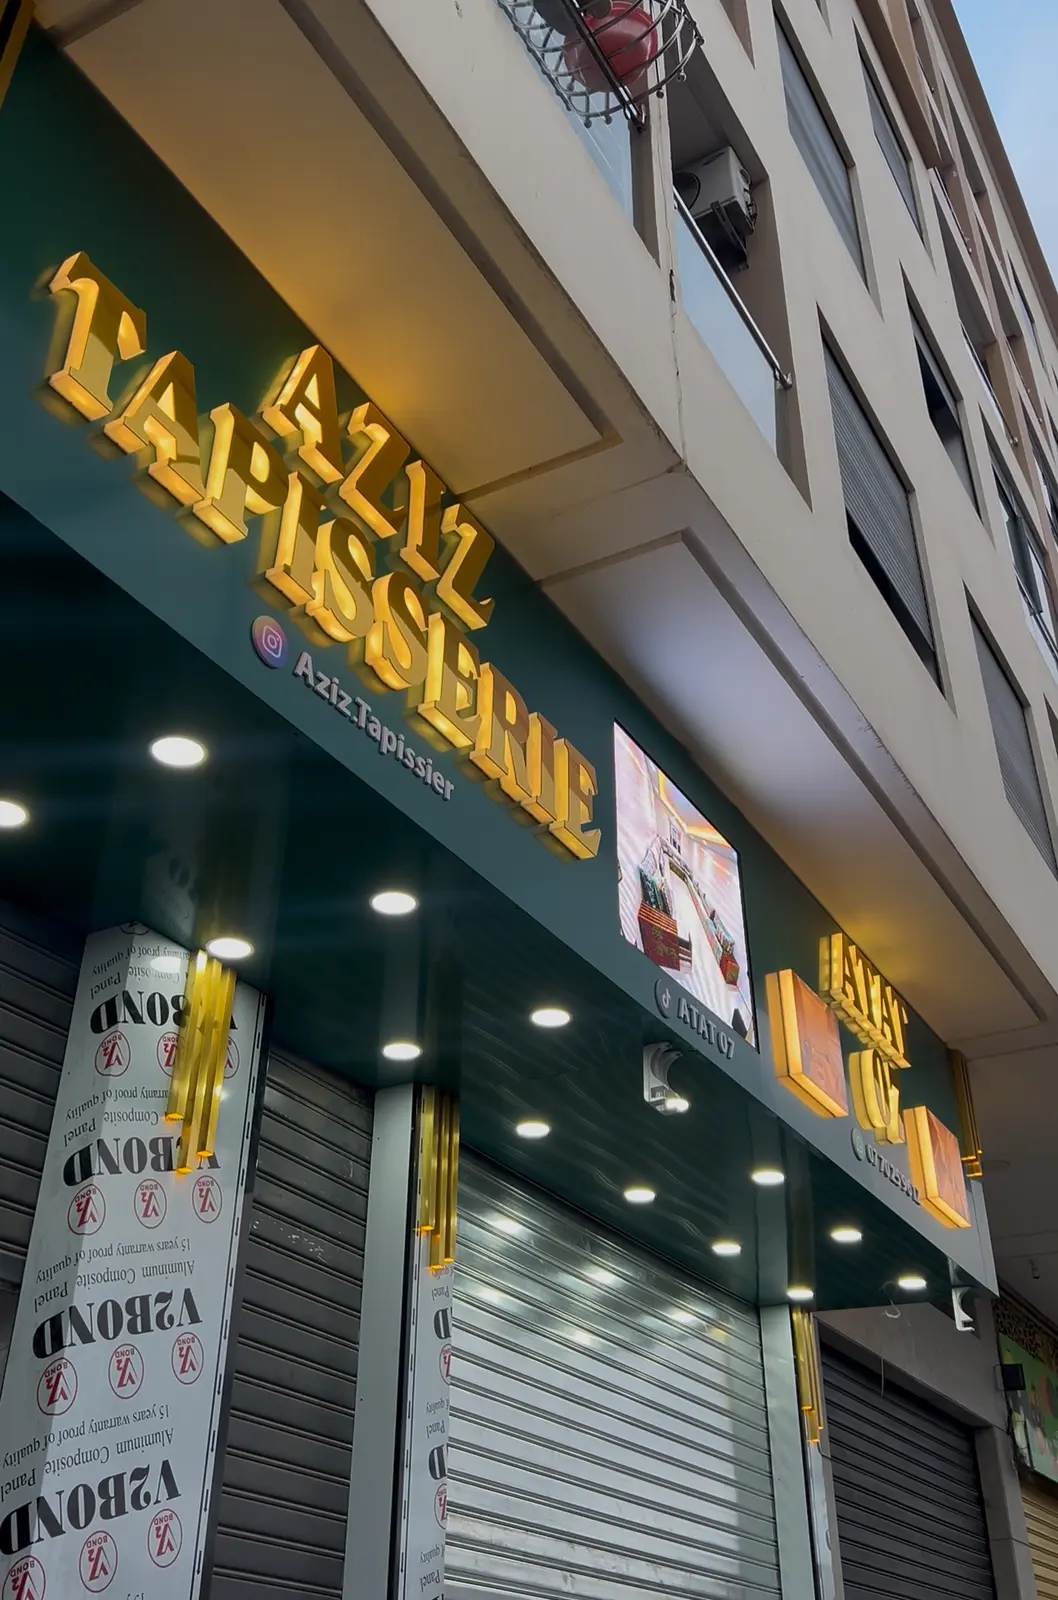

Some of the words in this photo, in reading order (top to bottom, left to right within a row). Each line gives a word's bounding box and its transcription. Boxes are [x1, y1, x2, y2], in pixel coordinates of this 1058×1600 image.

[262, 344, 495, 630] AZIZ
[49, 250, 600, 860] TAPISSERIE
[292, 652, 454, 801] Aziz.Tapissier
[92, 951, 124, 977] quality
[137, 946, 160, 958] proof
[89, 972, 121, 1000] Panel
[677, 998, 716, 1044] ATAT
[717, 1032, 735, 1059] 07
[100, 1089, 112, 1104] of
[113, 1087, 138, 1102] proof
[140, 1086, 169, 1100] arranty
[65, 1093, 99, 1122] quality
[104, 1108, 159, 1126] Composite
[64, 1118, 96, 1147] Panel
[87, 1247, 113, 1264] proof
[116, 1242, 154, 1256] warranty
[157, 1237, 179, 1249] years
[181, 1238, 191, 1252] 15
[36, 1256, 72, 1283] quality
[74, 1250, 86, 1267] of
[141, 1260, 195, 1279] Aluminum
[76, 1268, 136, 1290] Composite
[34, 1281, 69, 1313] Panel
[33, 1288, 203, 1359] V2BOND
[88, 1414, 130, 1434] warranty
[133, 1404, 157, 1421] years
[159, 1404, 169, 1420] 15
[42, 1432, 55, 1452] of
[56, 1421, 86, 1446] proof
[116, 1427, 174, 1454] Aluminum
[2, 1438, 41, 1469] quality
[45, 1446, 110, 1476] Composite
[0, 1468, 36, 1501] Panel
[0, 1459, 182, 1555] V2BOND
